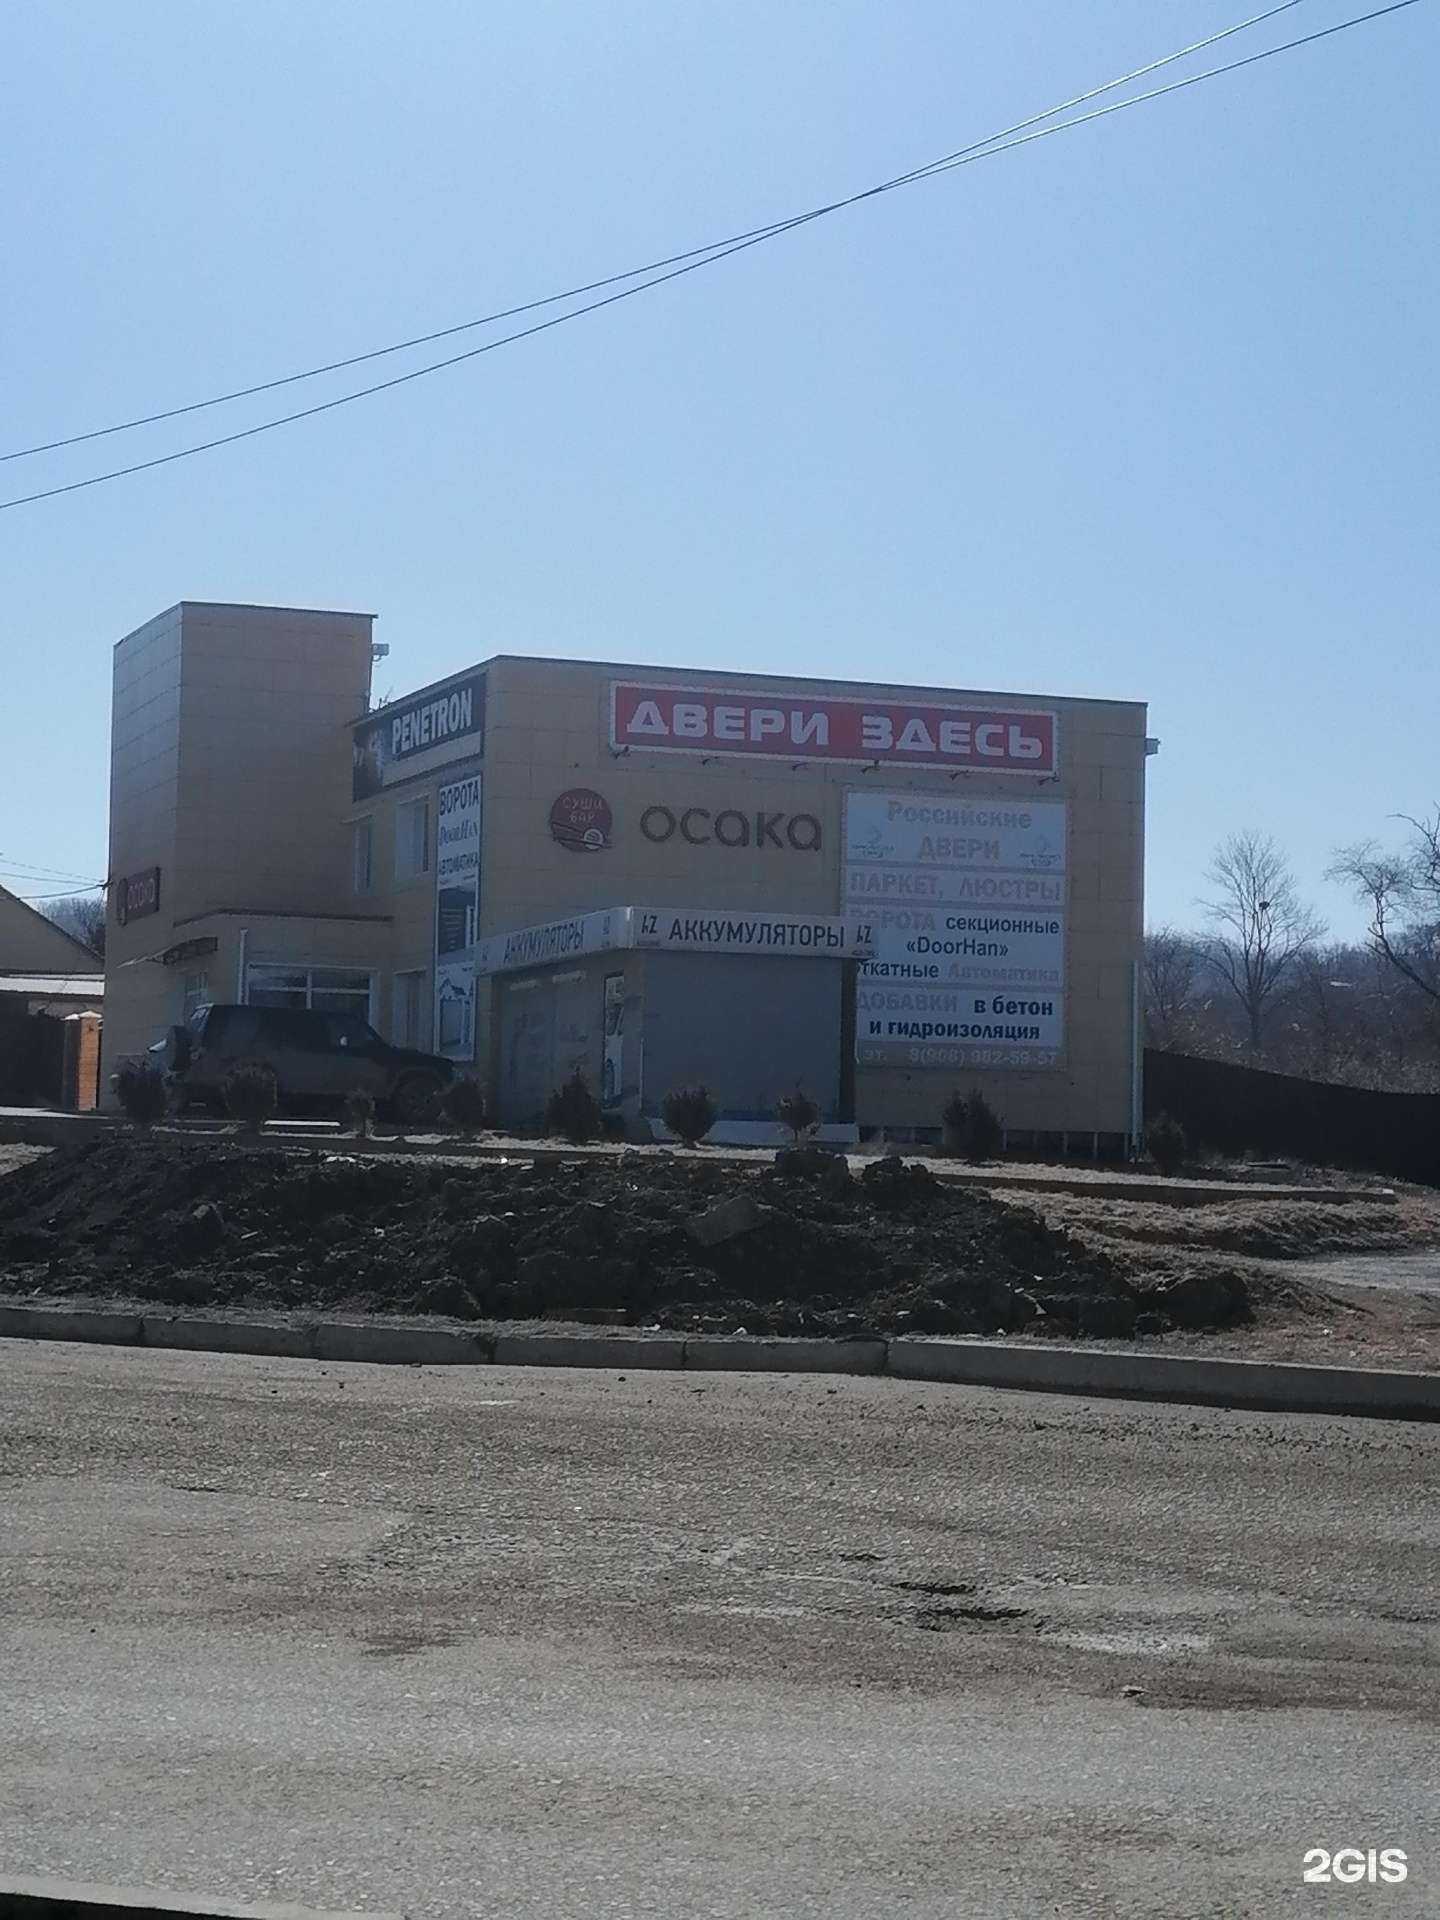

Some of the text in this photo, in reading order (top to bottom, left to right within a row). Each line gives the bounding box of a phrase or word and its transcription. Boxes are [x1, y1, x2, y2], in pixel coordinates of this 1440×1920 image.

[391, 687, 472, 755] PENETRON
[627, 701, 1043, 759] ДВЕРИ ЗДЕСЬ
[440, 780, 479, 816] ВОРОТА
[918, 836, 1000, 863] ДВЕРИ
[850, 872, 1061, 901] ПАРКЕТ, ЛЮСТРЫ
[668, 918, 845, 948] АККУМУЛЯТОРЫ
[945, 916, 1060, 935] секционные
[906, 936, 1009, 957] «DoorHan»
[974, 1000, 986, 1014] в
[992, 995, 1053, 1016] бетон
[870, 1021, 1040, 1041] и гидроизоляция
